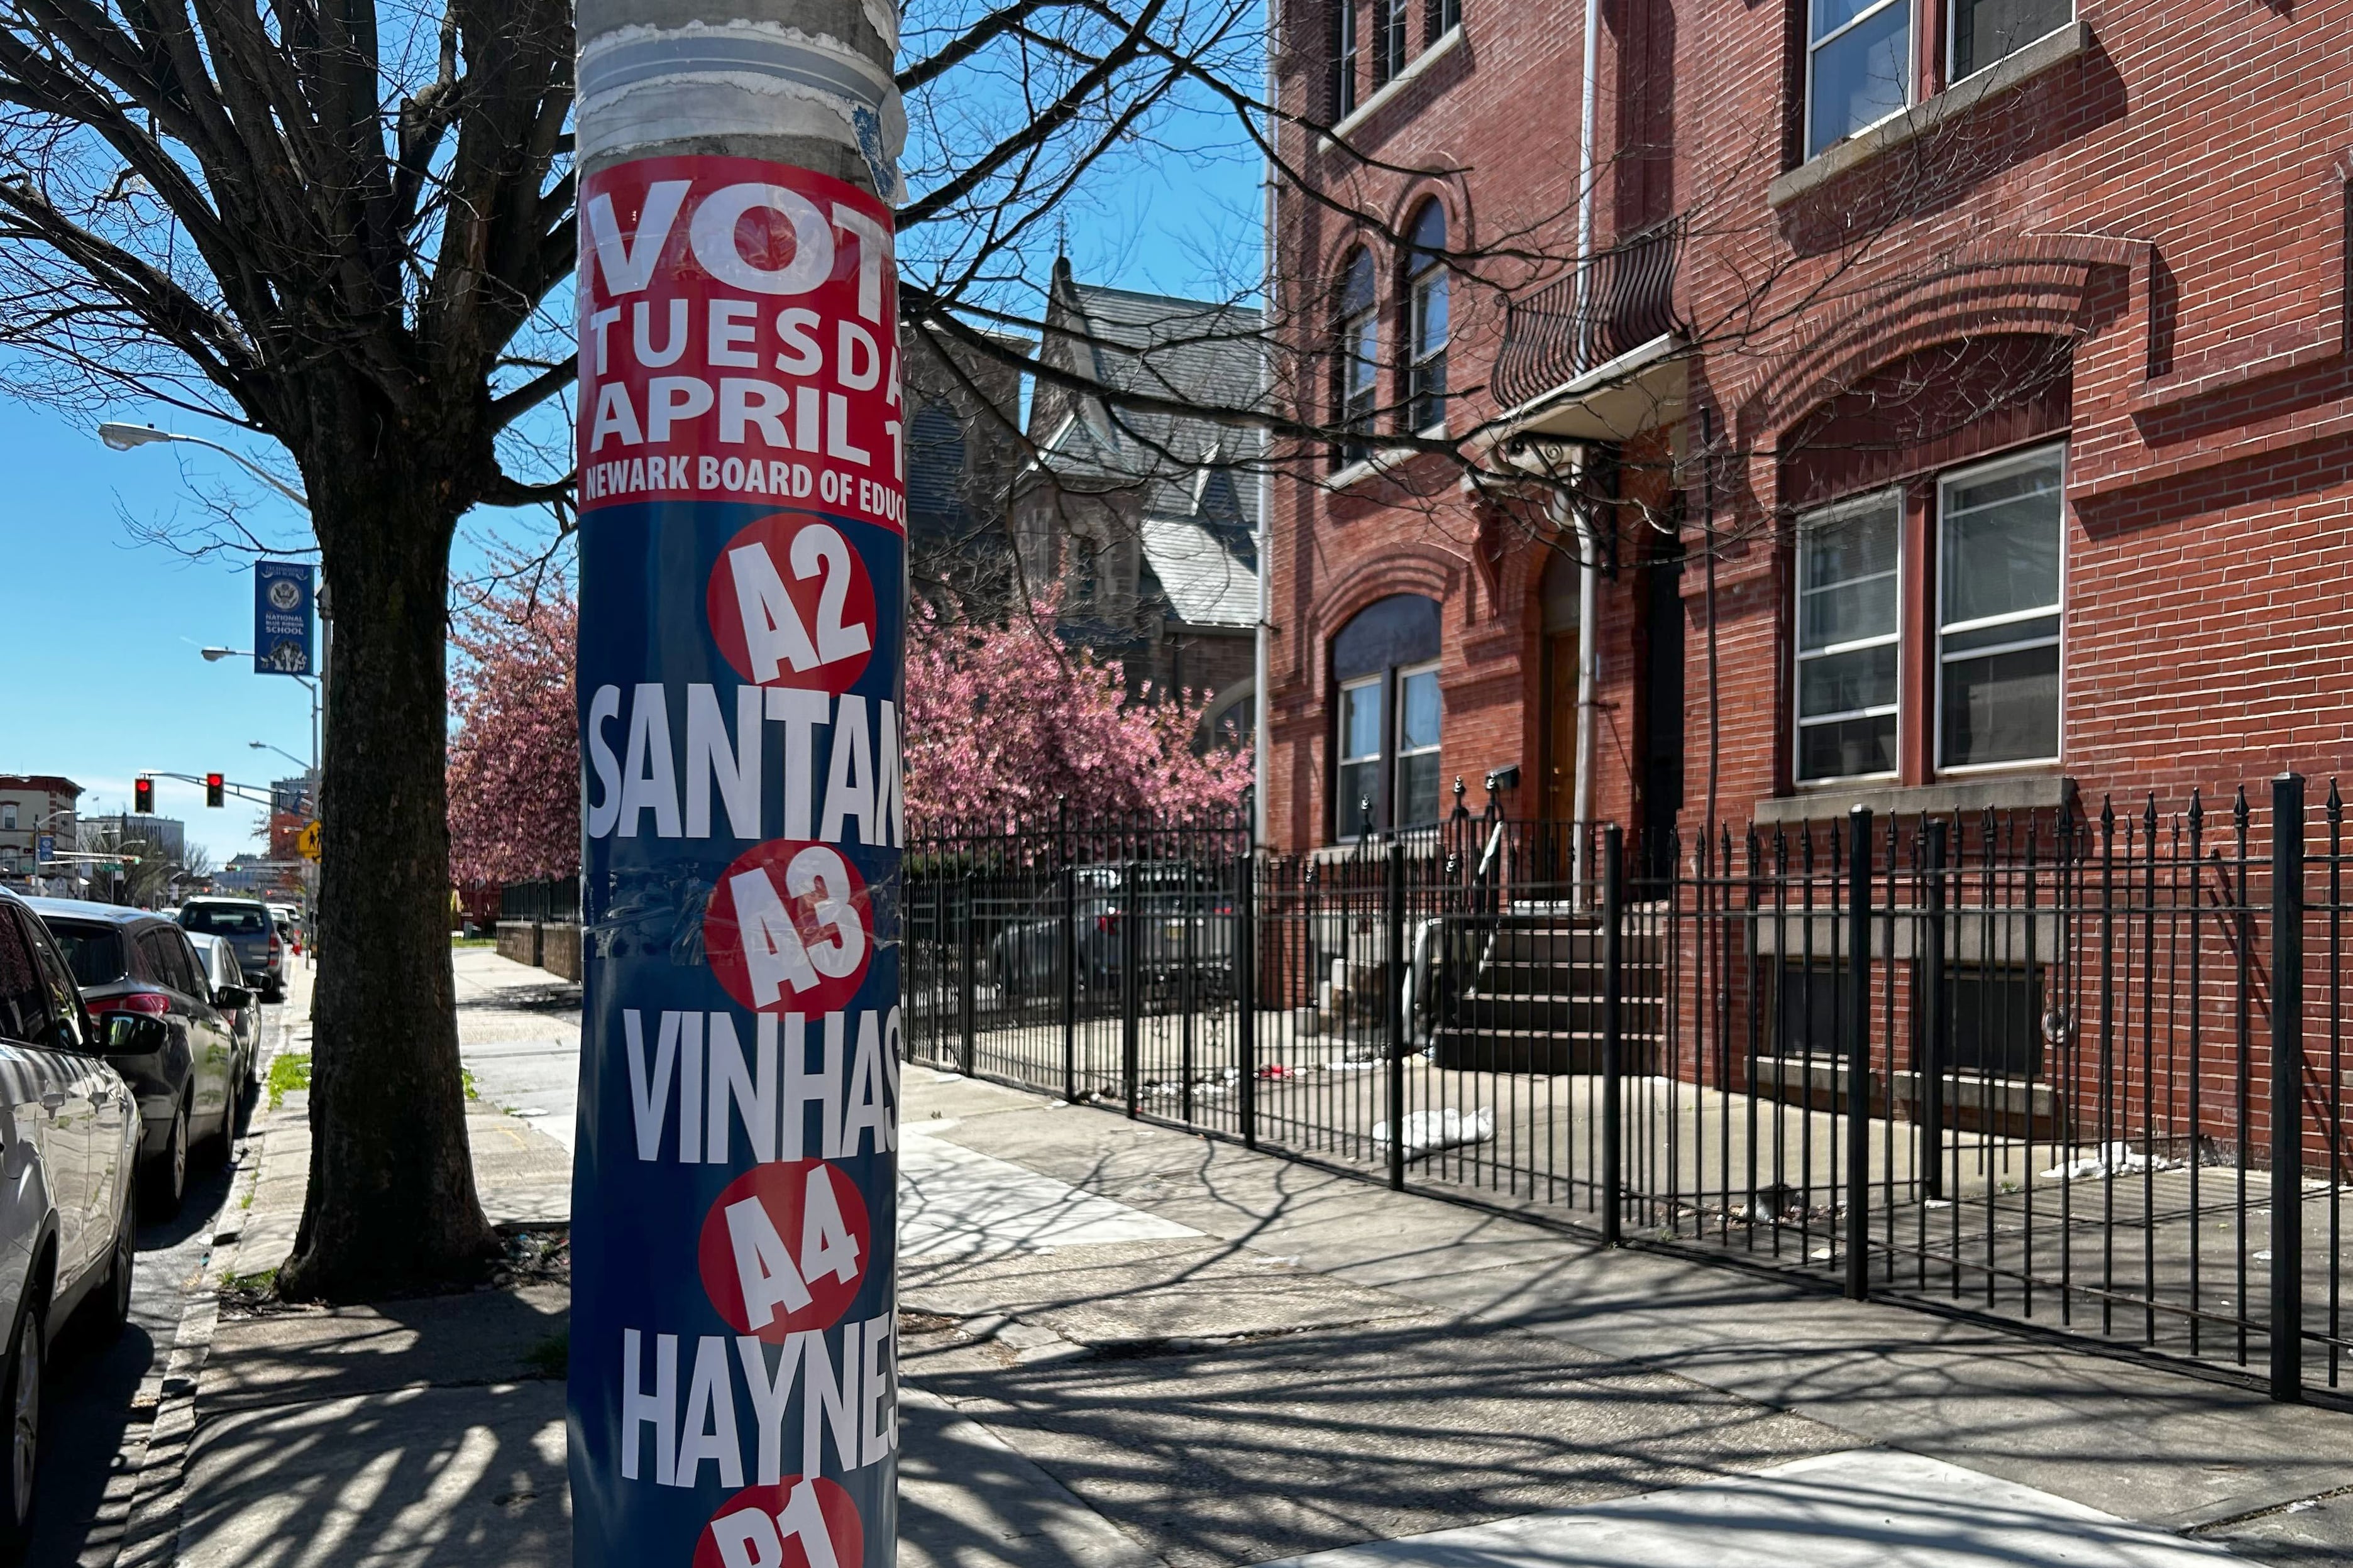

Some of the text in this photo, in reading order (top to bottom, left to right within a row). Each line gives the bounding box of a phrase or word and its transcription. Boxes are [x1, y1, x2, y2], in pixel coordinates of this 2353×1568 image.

[587, 180, 895, 326] VOT
[590, 299, 903, 412] TUESDA
[590, 376, 903, 483] APRIL 1
[586, 456, 691, 500] NEWARK
[698, 456, 813, 498] BOARD
[820, 469, 853, 507] OF
[265, 613, 303, 623] NATIONAL
[265, 627, 304, 635] SCHOOL
[728, 524, 871, 684] A2
[588, 683, 903, 848] SANTAN
[729, 846, 866, 1009] A3
[623, 1005, 900, 1164] VINHAS
[725, 1163, 861, 1332] A4
[622, 1300, 898, 1488] HAYNES
